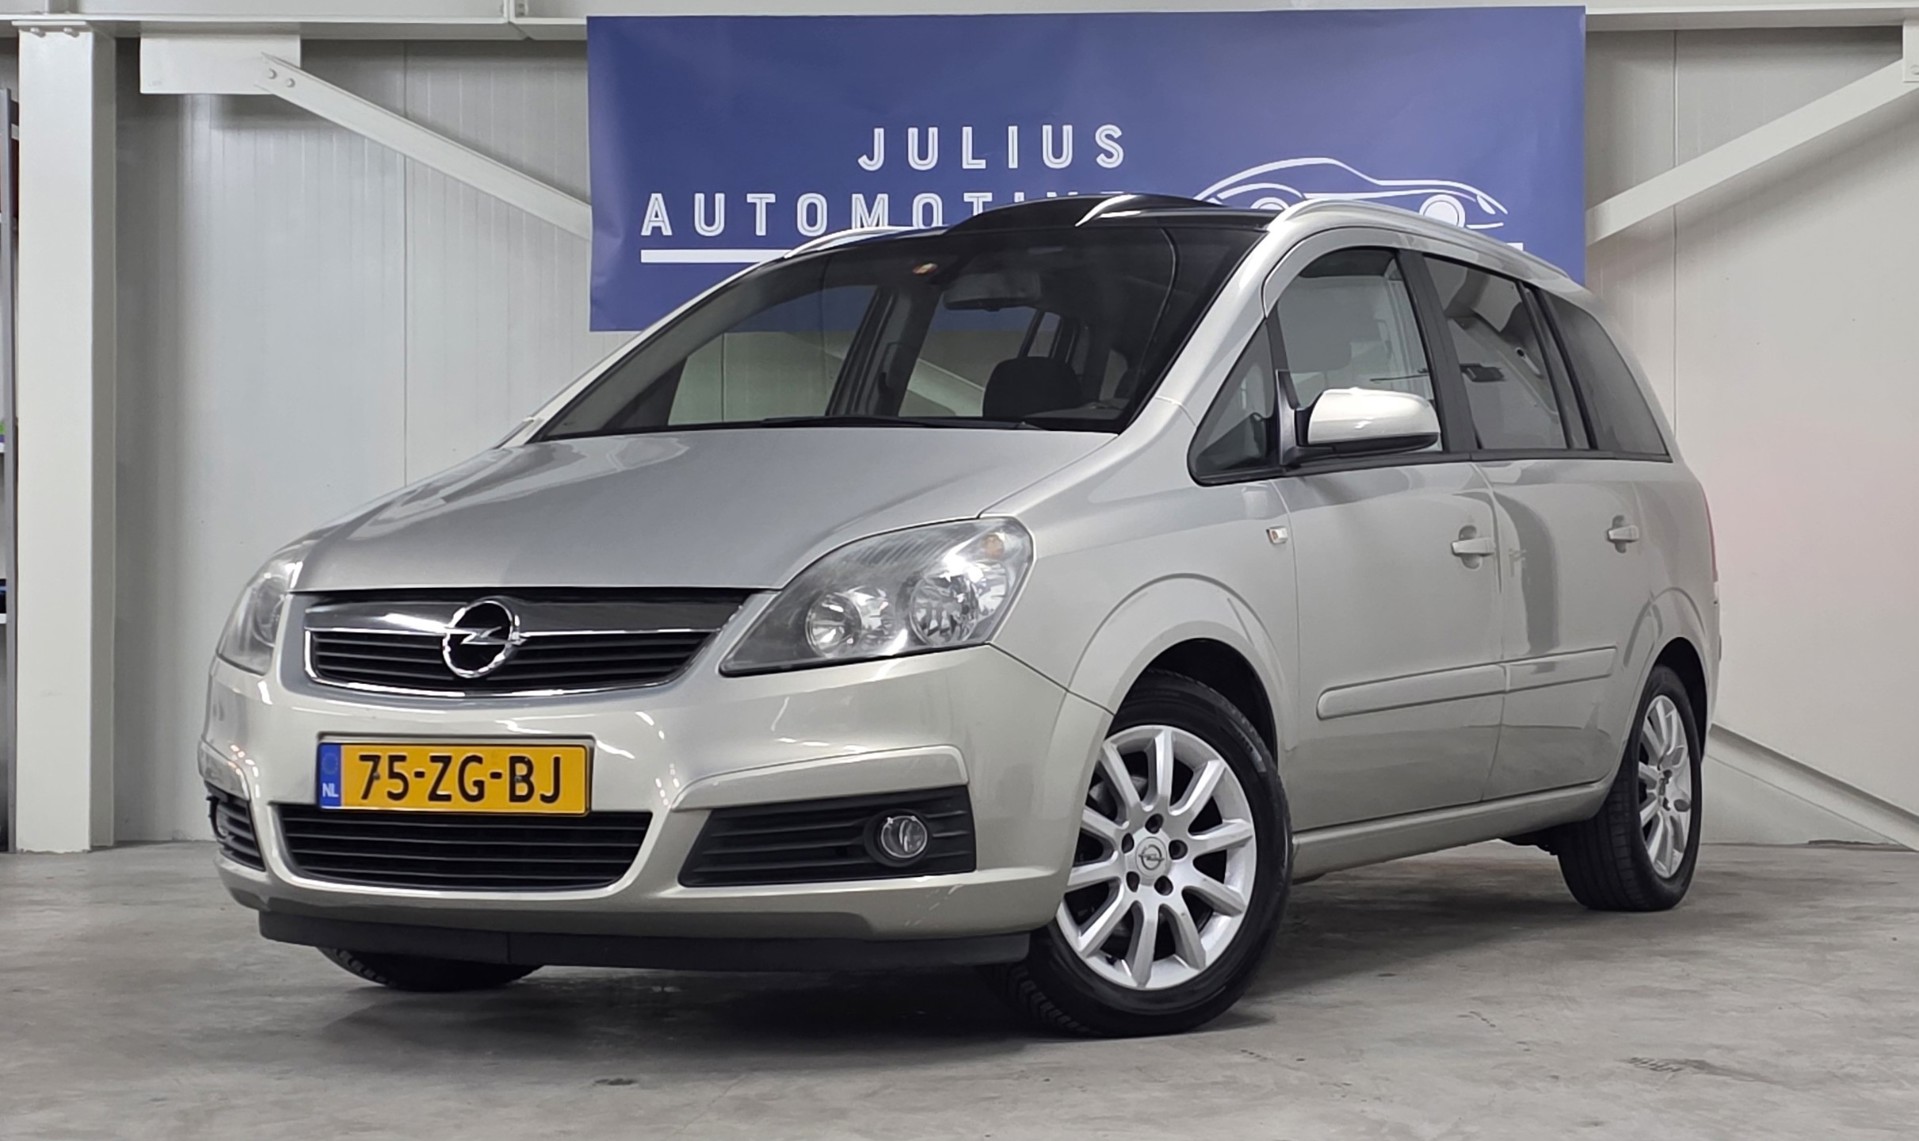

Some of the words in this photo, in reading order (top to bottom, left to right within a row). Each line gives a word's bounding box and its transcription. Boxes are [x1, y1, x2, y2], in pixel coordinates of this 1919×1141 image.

[858, 124, 1124, 171] JULIUS
[641, 191, 1124, 236] AUTOMOT
[322, 782, 339, 798] NL
[359, 754, 561, 803] 75-ZG-BJ
